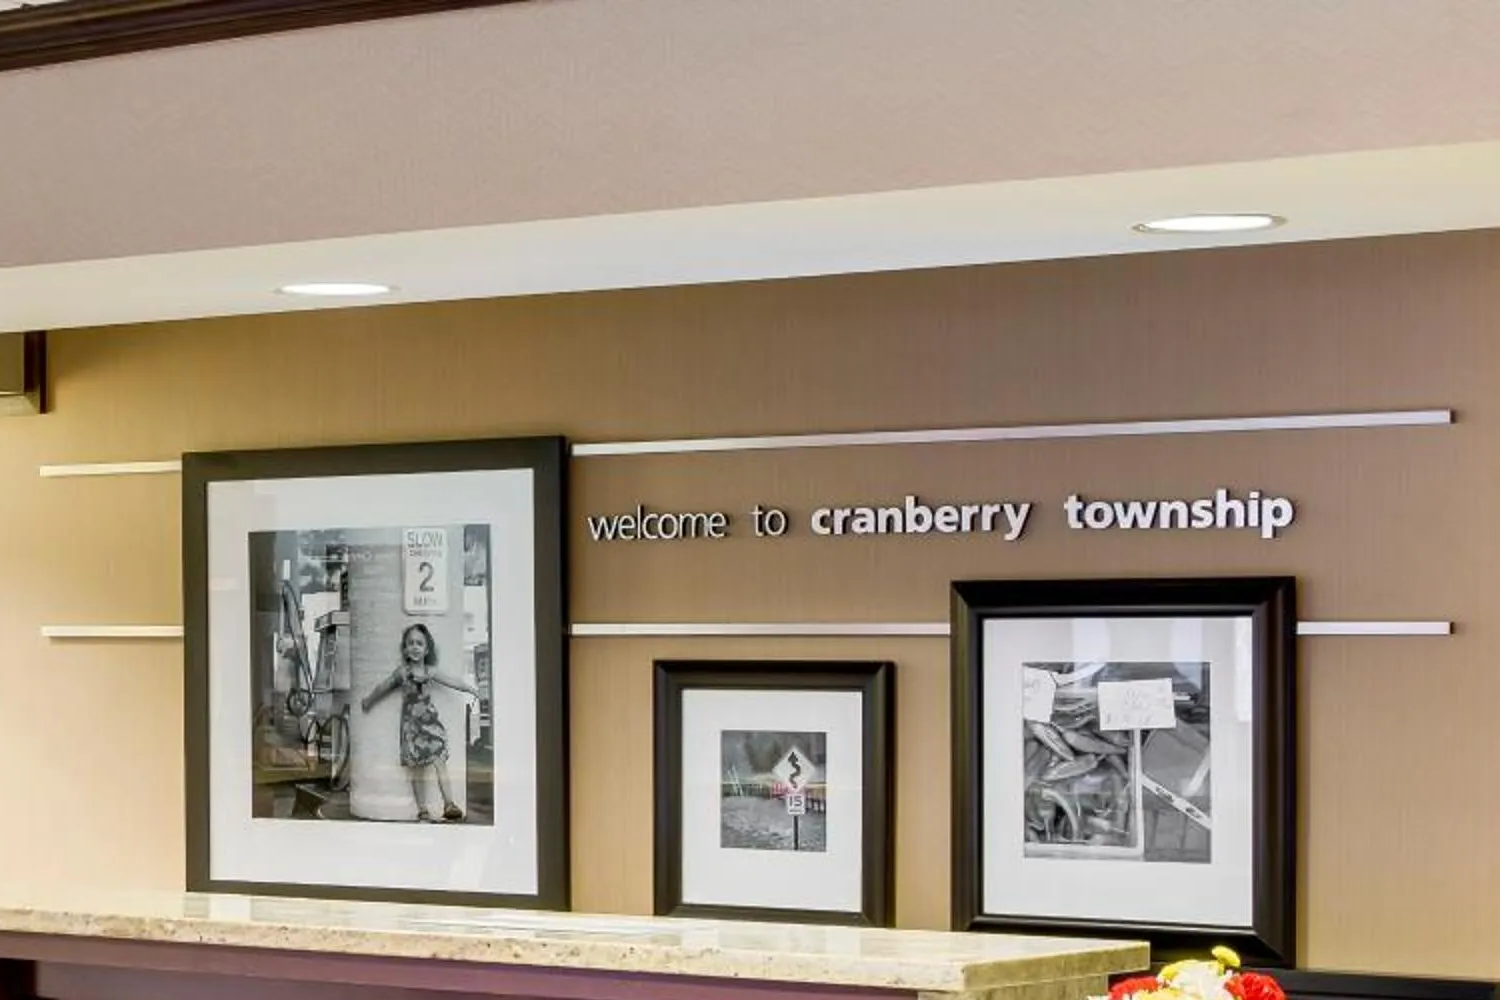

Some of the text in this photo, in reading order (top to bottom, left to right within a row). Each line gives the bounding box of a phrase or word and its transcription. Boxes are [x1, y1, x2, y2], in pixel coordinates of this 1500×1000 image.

[587, 487, 1296, 542] welcome to cranberry township
[419, 561, 435, 592] 2
